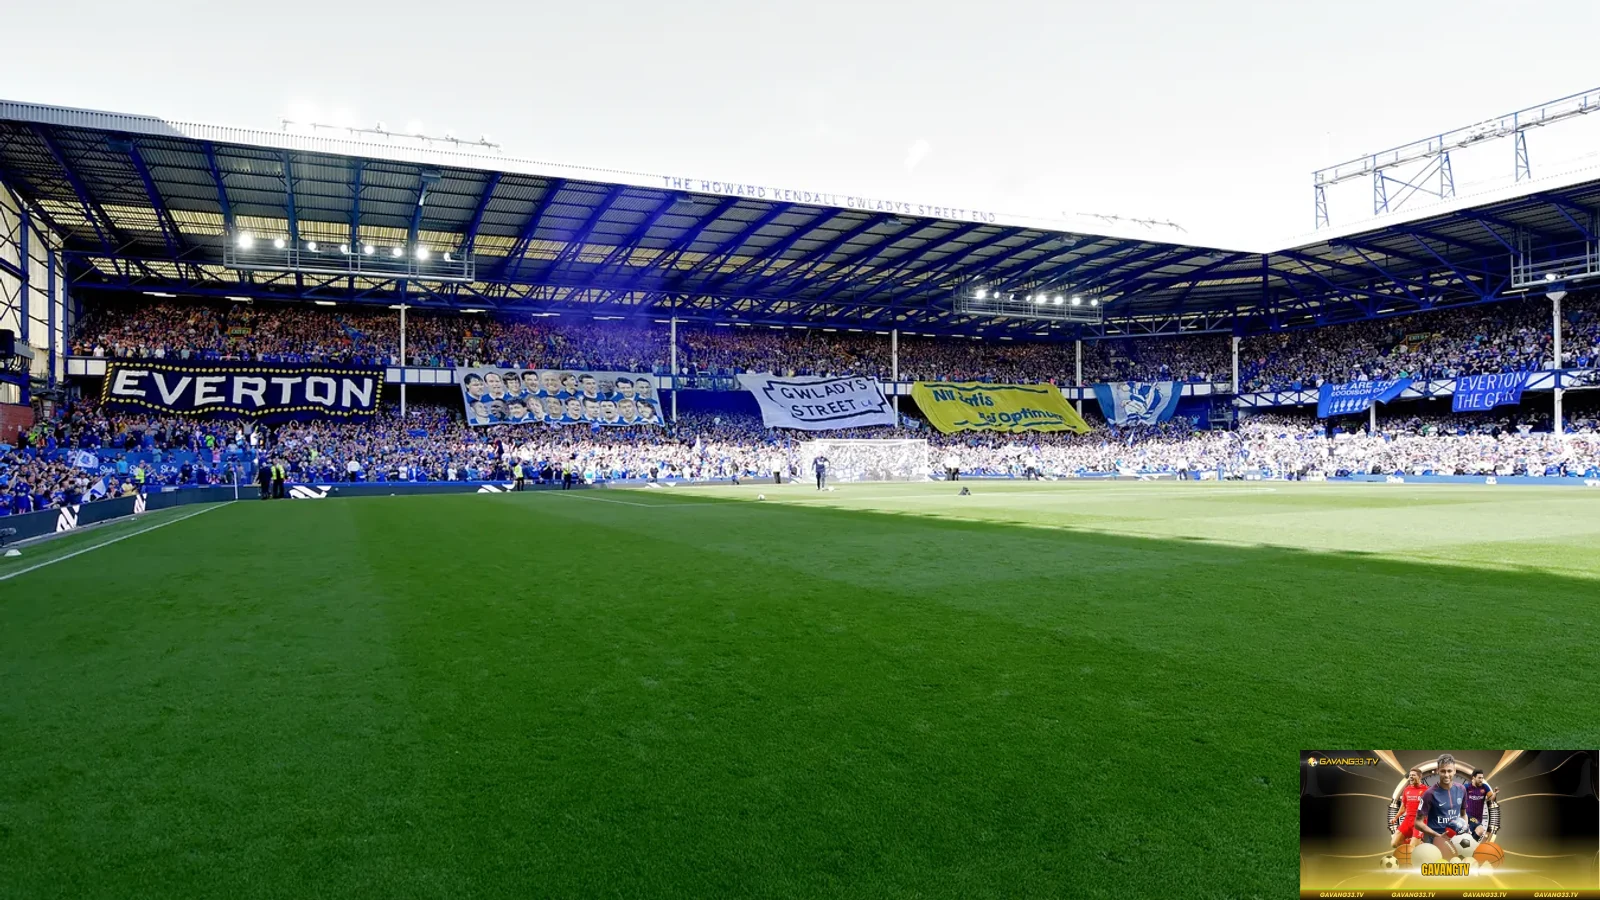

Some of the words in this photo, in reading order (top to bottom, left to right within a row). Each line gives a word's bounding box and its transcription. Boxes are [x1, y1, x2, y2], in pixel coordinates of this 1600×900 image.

[662, 175, 692, 190] THE
[701, 179, 765, 198] HOWARD
[774, 188, 838, 206] KENDALL
[847, 196, 911, 214] GWLADYS
[918, 204, 965, 219] STREET
[972, 211, 996, 223] END
[112, 370, 373, 407] EVERTON
[780, 379, 867, 400] GWLADYS
[1332, 383, 1348, 391] WE
[1350, 381, 1374, 390] ARE
[1459, 372, 1526, 392] EVERTON
[791, 399, 856, 417] STREET
[1457, 393, 1482, 409] THE
